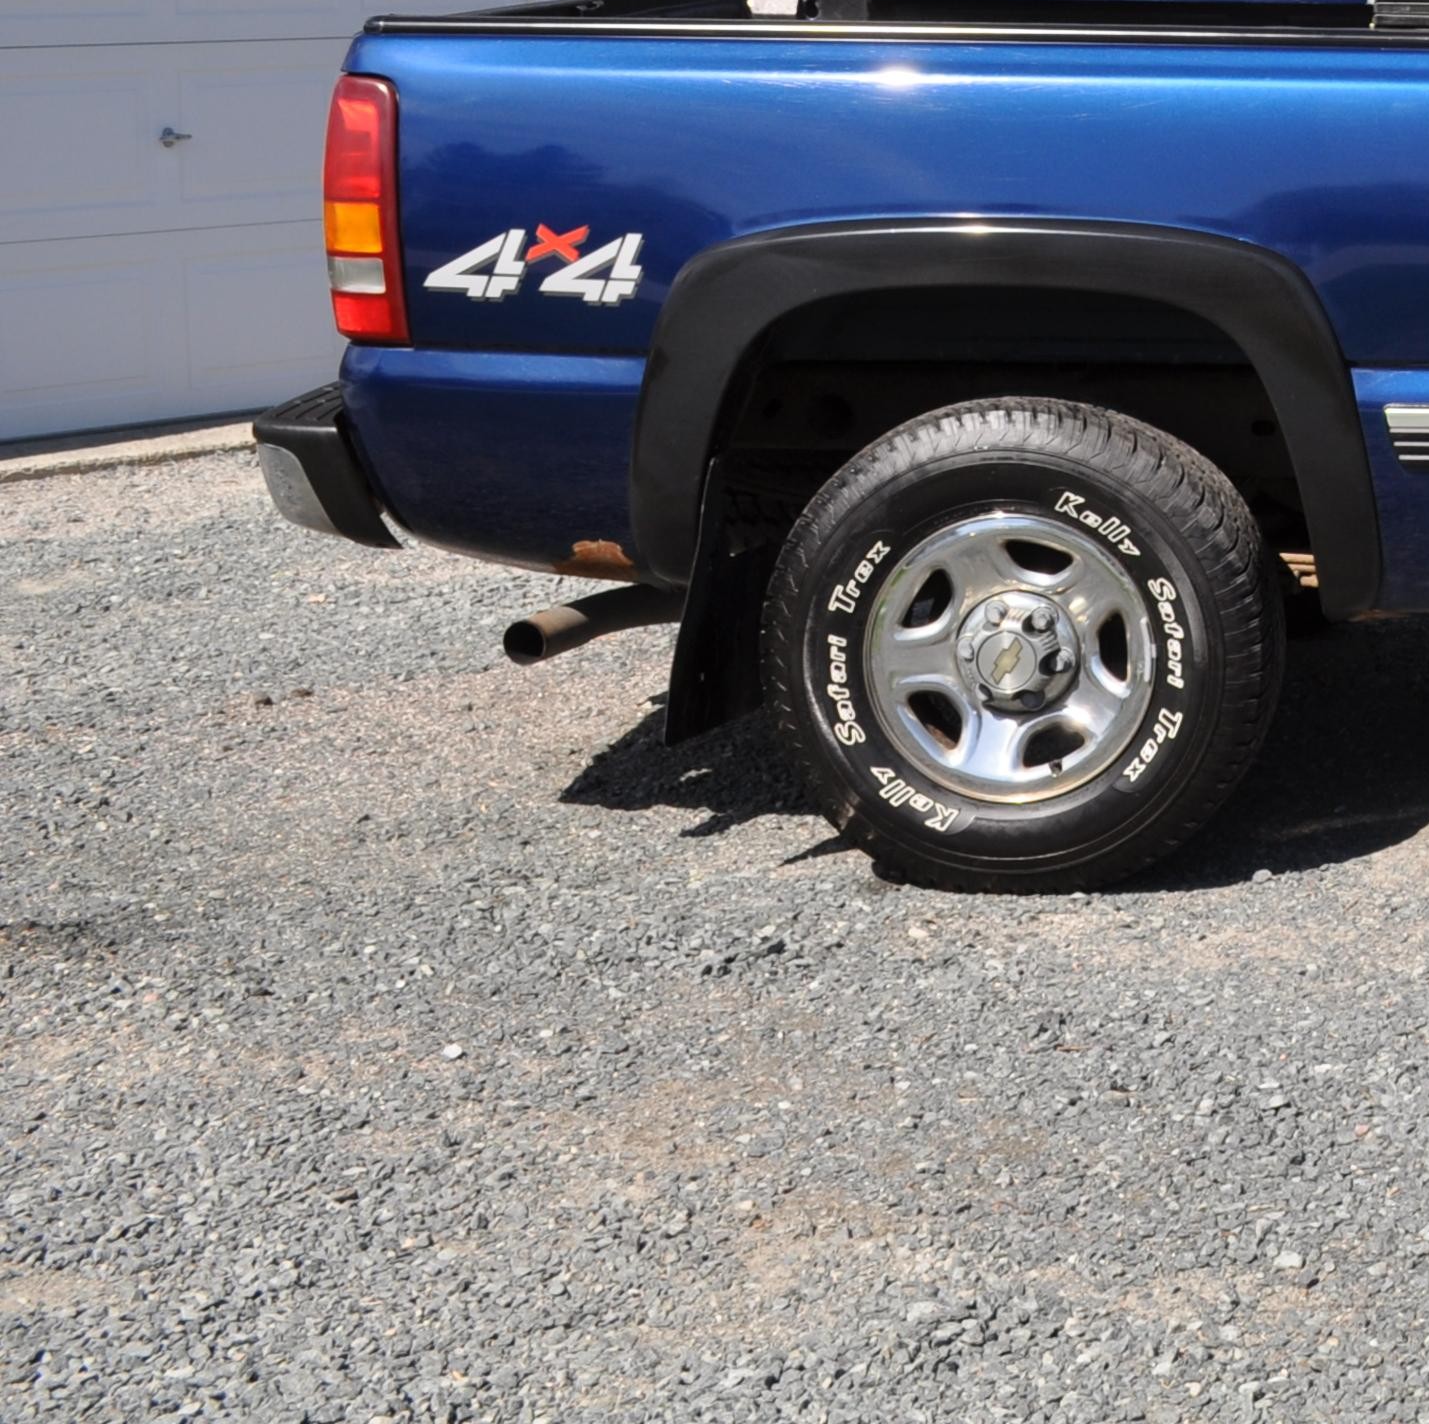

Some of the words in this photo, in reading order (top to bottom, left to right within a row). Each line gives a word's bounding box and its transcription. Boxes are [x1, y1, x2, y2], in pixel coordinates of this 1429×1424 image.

[1054, 491, 1141, 557] Kelly
[827, 540, 891, 614] Trex
[1147, 577, 1185, 689] Safari
[829, 635, 866, 746] Safari
[1123, 707, 1183, 782] Trex
[870, 765, 960, 832] Kelly
